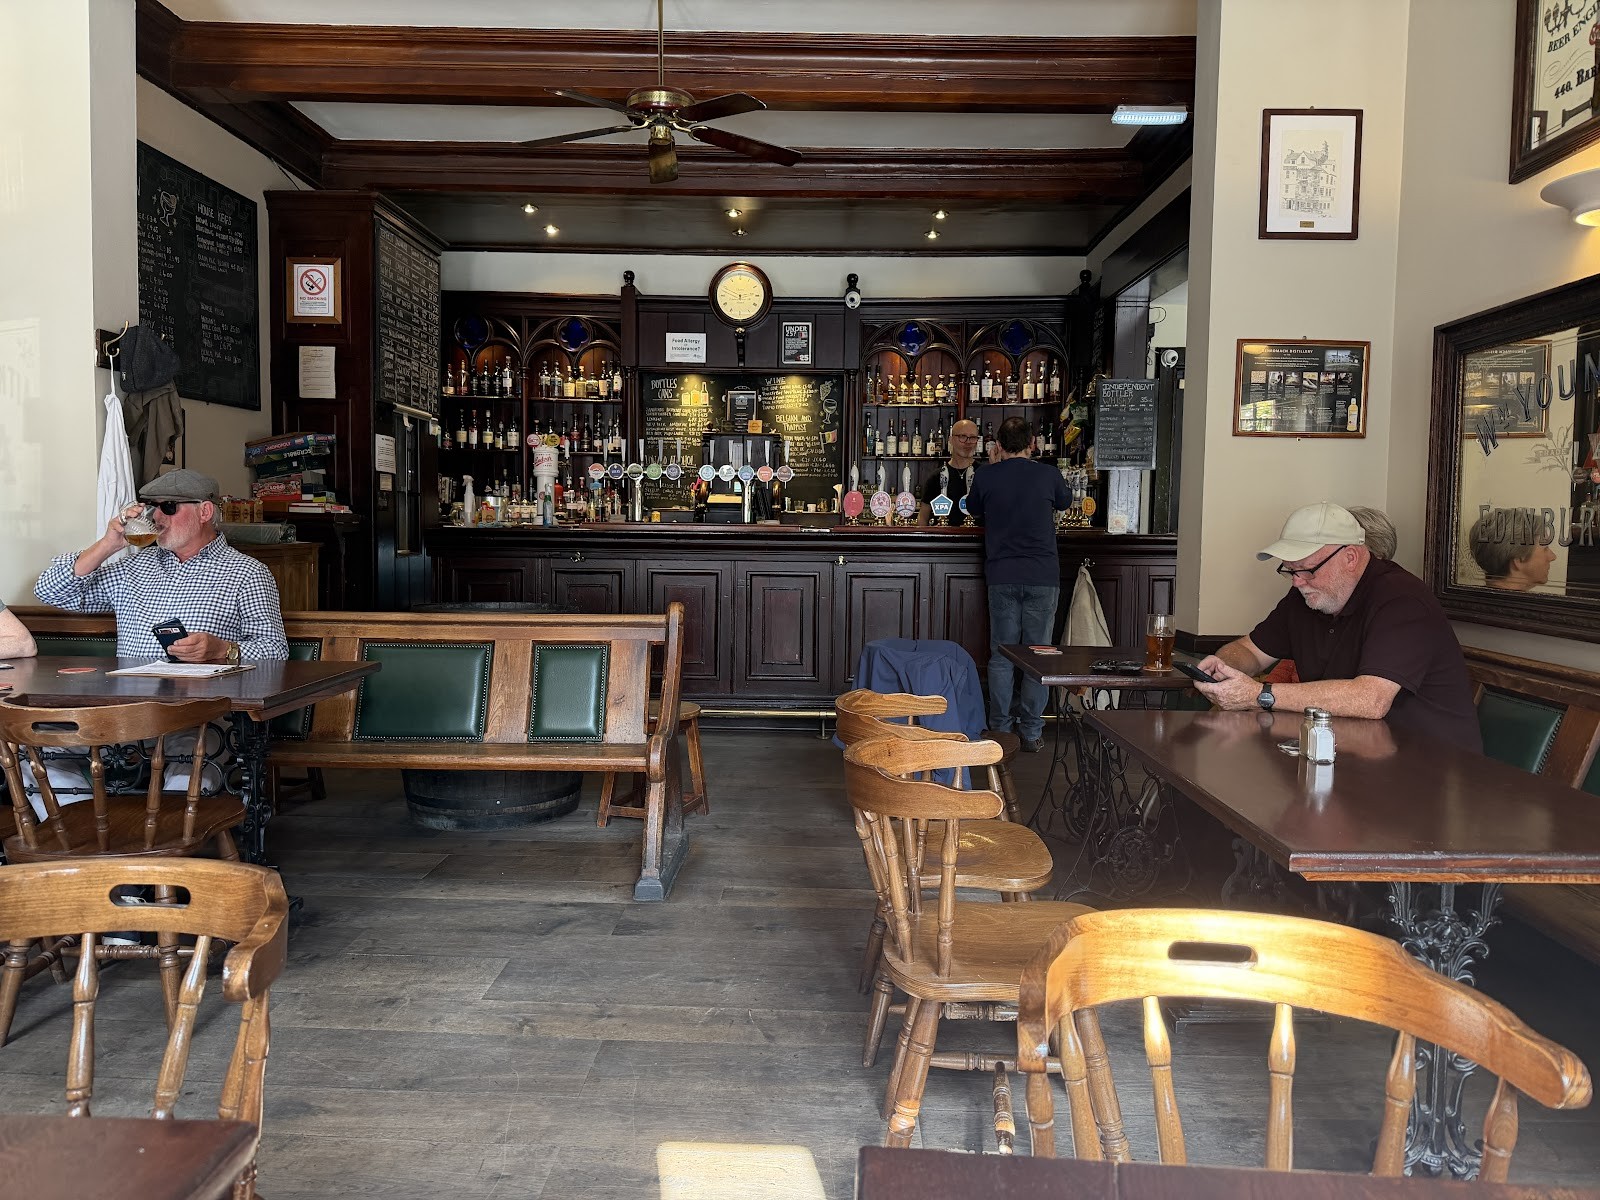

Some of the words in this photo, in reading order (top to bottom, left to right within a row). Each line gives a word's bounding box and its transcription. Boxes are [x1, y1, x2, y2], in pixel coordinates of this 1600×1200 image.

[1547, 33, 1571, 53] BEER
[651, 378, 678, 389] BOTTLES
[765, 377, 785, 386] WINE
[1102, 383, 1155, 391] INDEPENDENT
[658, 389, 673, 399] CANS
[1102, 390, 1134, 398] BOTTLER
[1102, 397, 1133, 405] WHISKY
[776, 415, 798, 423] BELGIAN
[265, 441, 292, 452] MONOPOLY
[1478, 504, 1595, 551] EDINBUR
